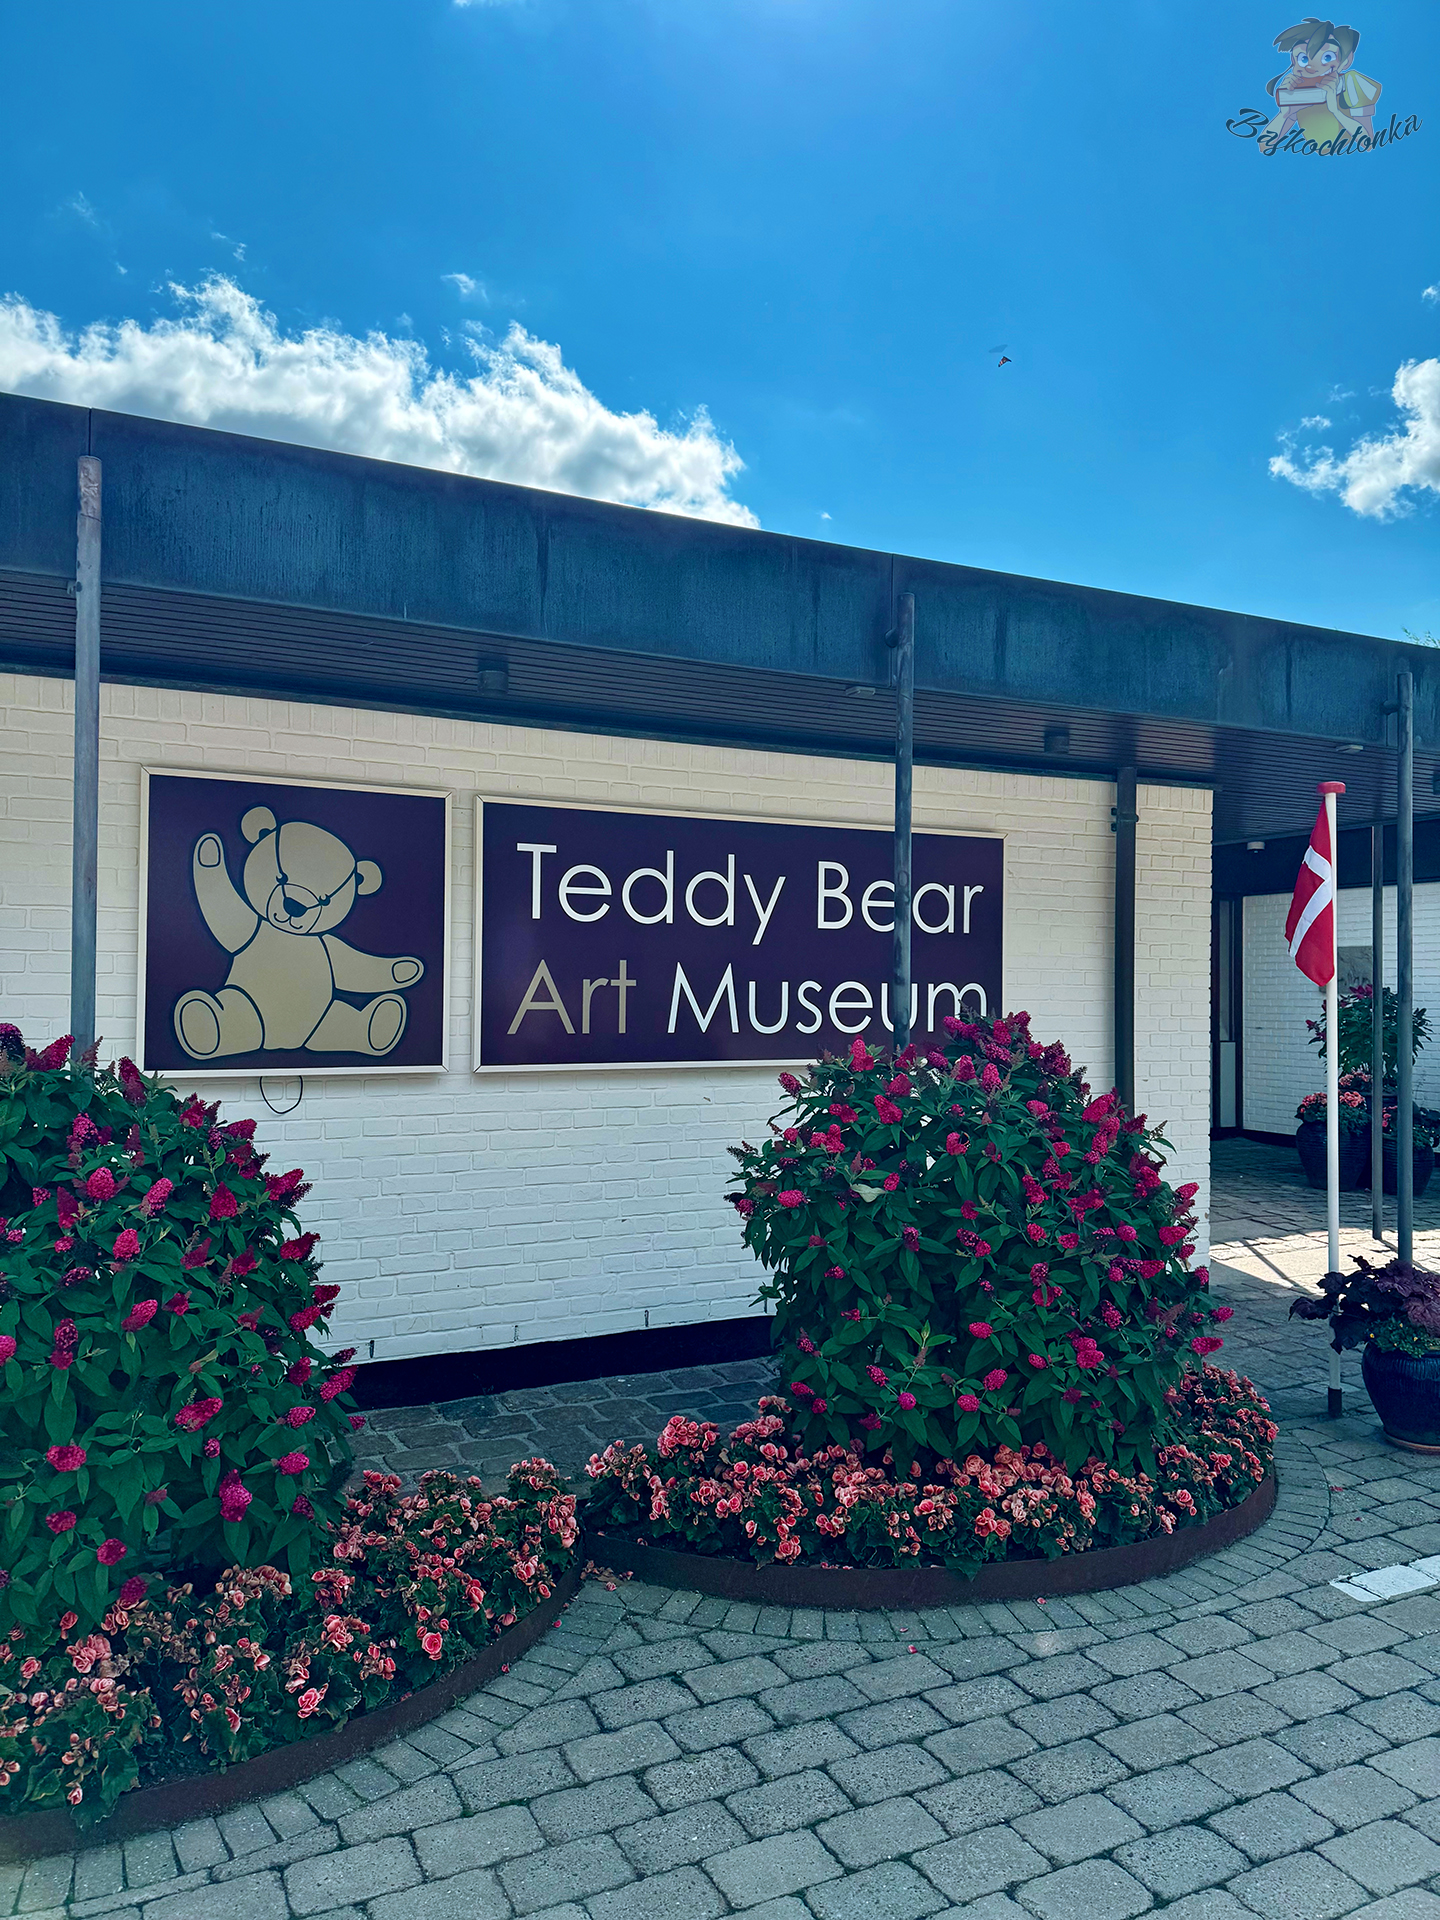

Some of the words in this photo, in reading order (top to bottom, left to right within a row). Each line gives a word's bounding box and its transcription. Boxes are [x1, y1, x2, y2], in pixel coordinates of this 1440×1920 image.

[516, 842, 787, 945] Teddy
[816, 860, 984, 934] Bear
[507, 959, 637, 1034] Art
[667, 961, 988, 1034] Museum
